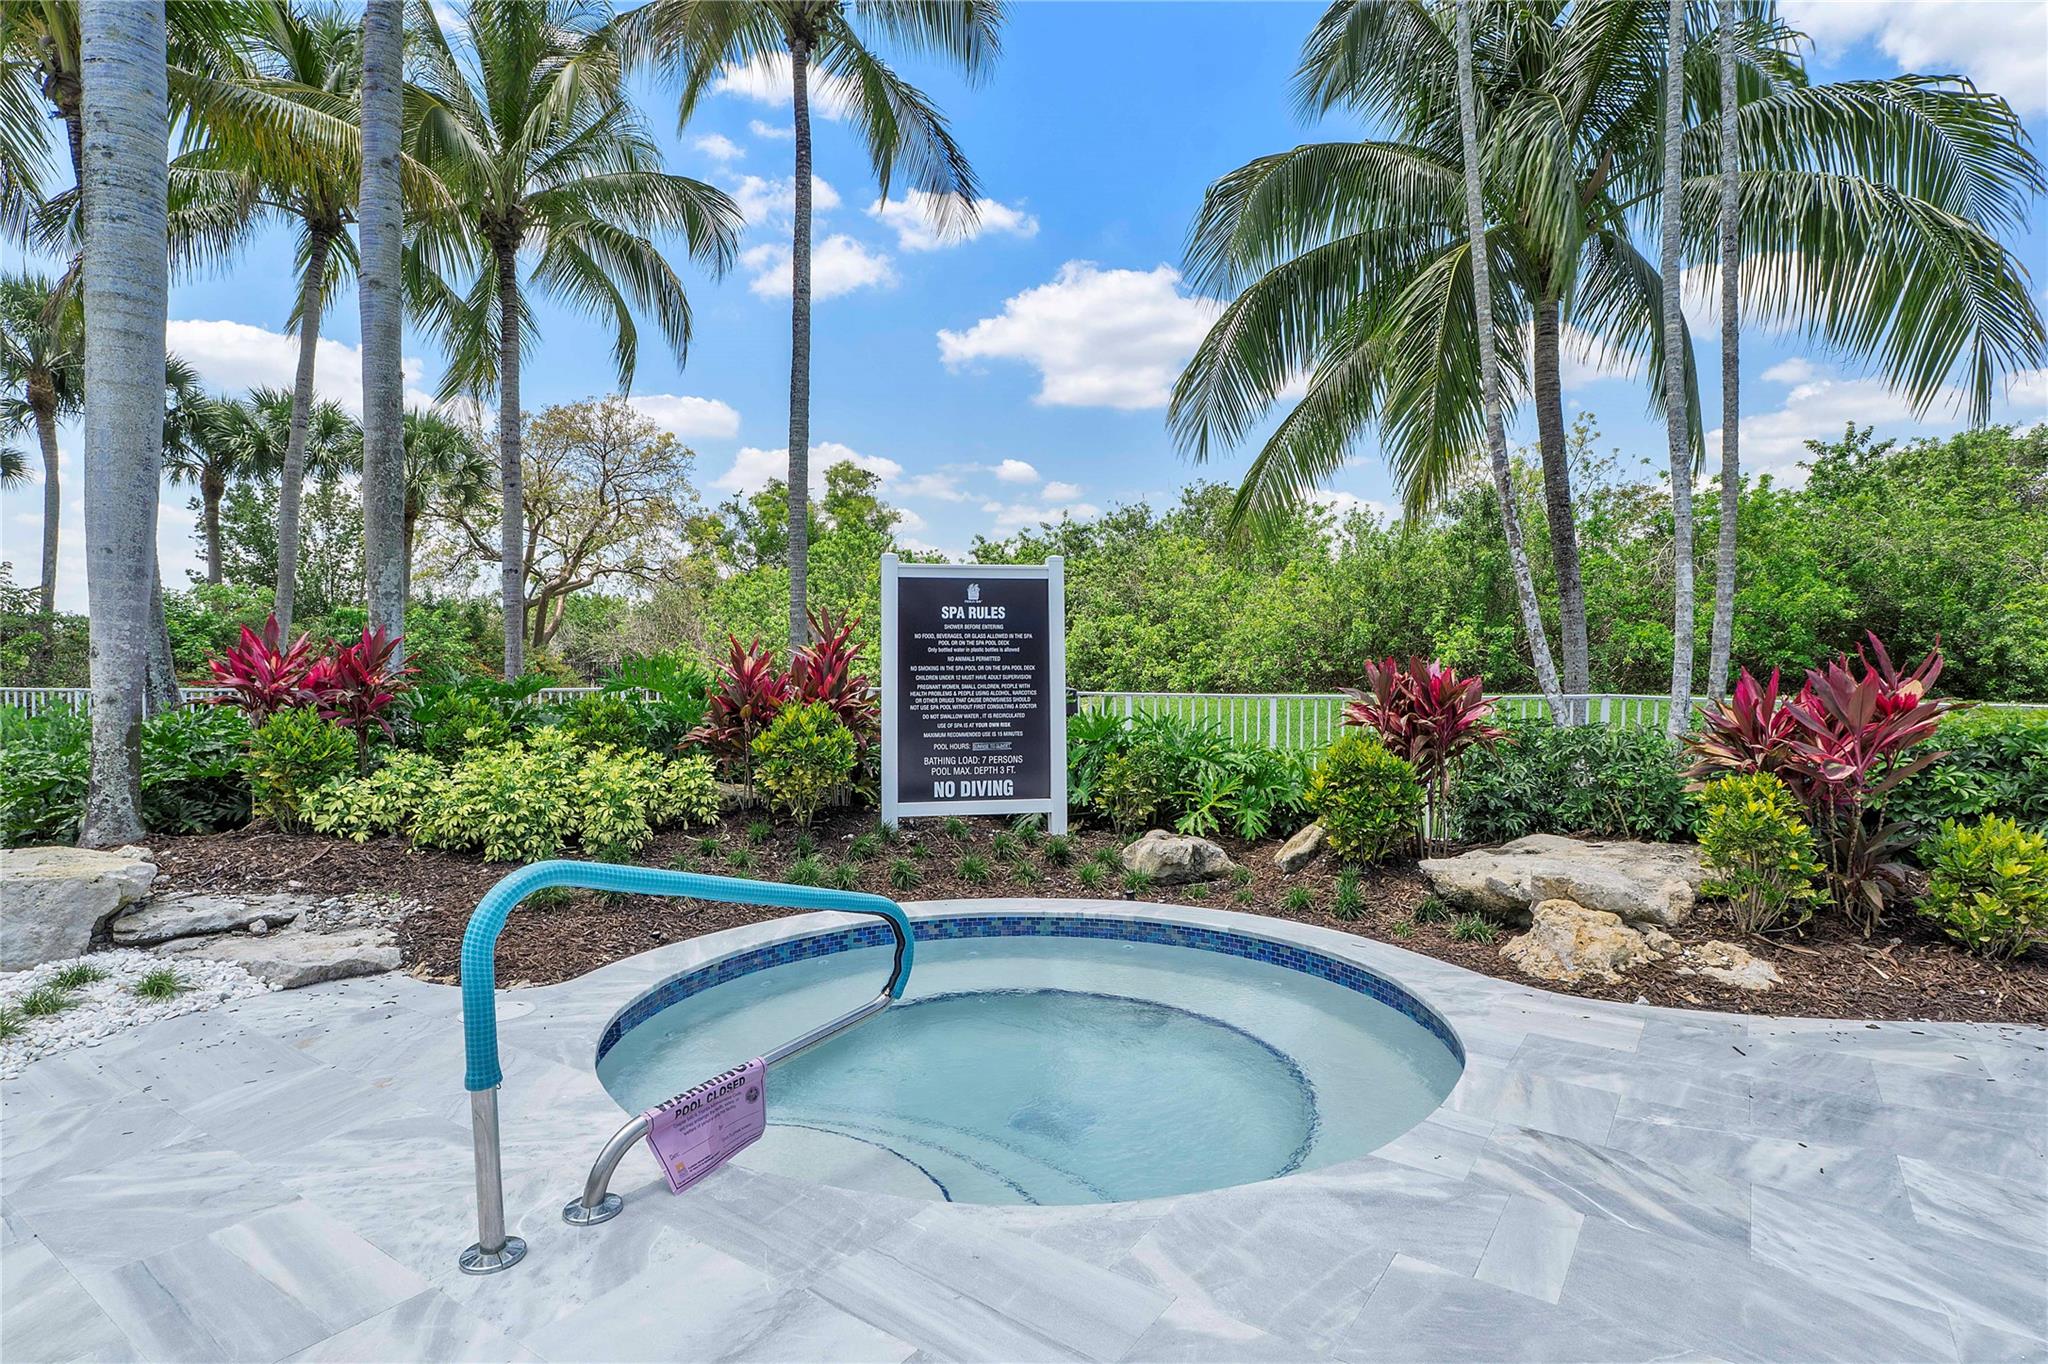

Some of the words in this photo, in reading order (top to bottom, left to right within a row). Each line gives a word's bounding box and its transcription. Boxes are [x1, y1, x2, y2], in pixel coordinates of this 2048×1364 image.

[941, 606, 965, 619] SPA
[968, 606, 1006, 619] RULES
[924, 757, 956, 765] BATHING
[958, 756, 981, 764] LOAD:
[988, 755, 1023, 764] PERSONS
[931, 767, 951, 776] POOL
[953, 767, 972, 775] MAX.
[1006, 766, 1016, 774] FT.
[934, 781, 956, 798] NO
[960, 780, 1014, 798] DIVING
[675, 1102, 703, 1120] POOL
[706, 1076, 746, 1104] CLOSED
